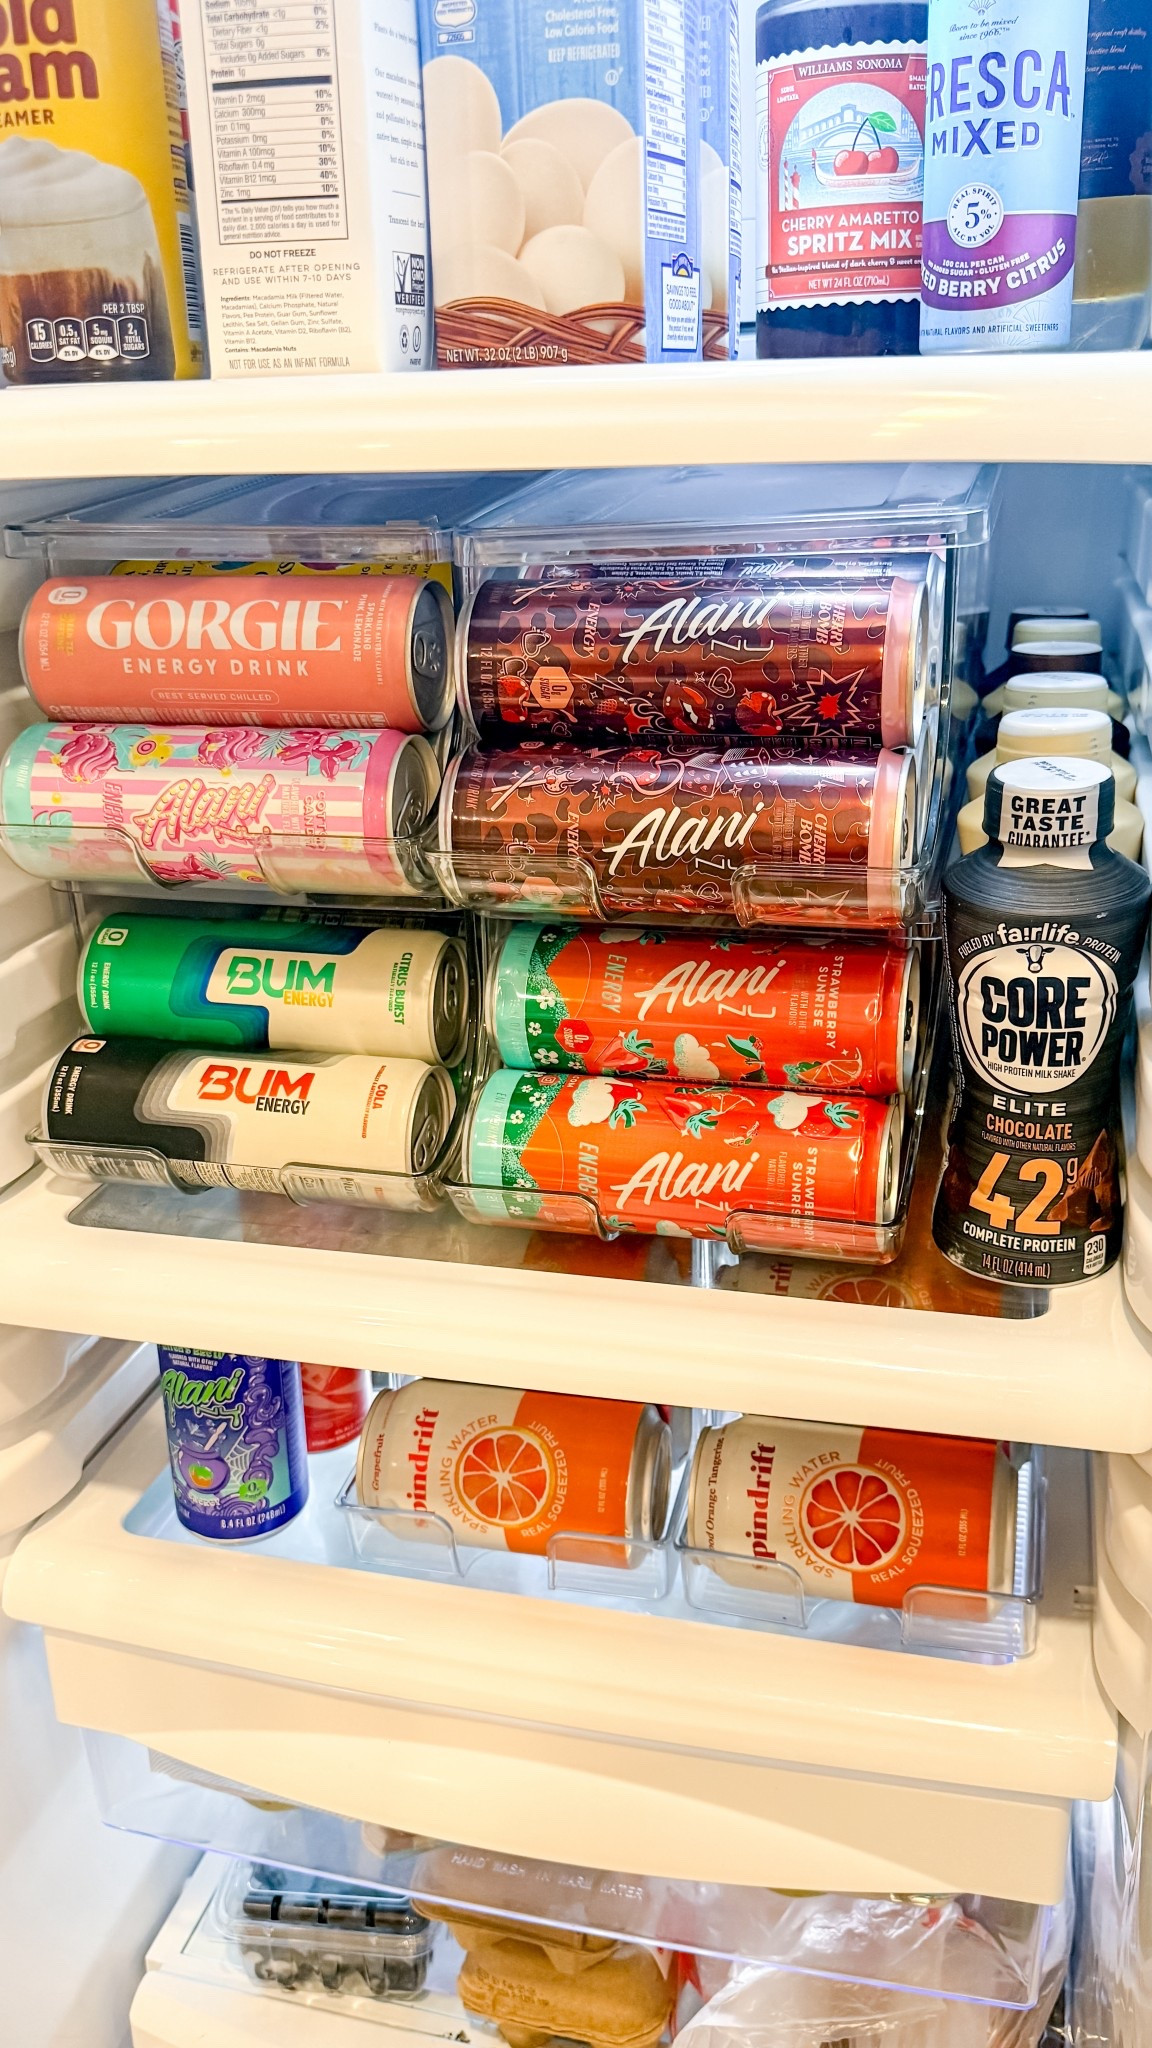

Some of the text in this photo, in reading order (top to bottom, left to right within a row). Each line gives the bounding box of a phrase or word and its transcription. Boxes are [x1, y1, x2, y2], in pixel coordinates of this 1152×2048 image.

[224, 10, 270, 22] Carbohydrate
[597, 22, 619, 34] Food
[548, 43, 621, 63] KEEP REFRIGERATED
[211, 69, 235, 79] Protein
[798, 58, 903, 78] WILLIAMS SONOMA
[314, 89, 332, 99] 10%
[927, 50, 1071, 123] RESCA
[0, 109, 54, 128] AMER
[315, 103, 333, 113] 25%
[318, 143, 336, 153] 10%
[931, 118, 1041, 158] MIXED
[318, 157, 337, 167] 30%
[319, 170, 338, 180] 40%
[321, 183, 339, 193] 10%
[953, 187, 997, 210] REAL SPIRIT
[781, 210, 920, 233] CHERRY AMARETTO
[964, 201, 992, 229] 5%
[787, 230, 864, 256] SPRITZ
[871, 229, 913, 250] MIX
[952, 224, 995, 241] ALC VOL
[250, 248, 316, 259] DO NOT FREEZE
[412, 257, 425, 269] NON
[942, 255, 1005, 269] 100 CAL PER CAN
[950, 252, 1031, 277] SUGAR GLUTEN FREE
[213, 262, 361, 276] REFRIGERATE AFTER OPENING
[222, 273, 352, 286] AND USE WITHIN 7-10 DAYS
[937, 237, 1067, 298] BERRY CITRUS
[808, 280, 822, 291] NET
[103, 302, 145, 314] PER TBSP
[397, 293, 425, 305] VERIFIED
[32, 323, 46, 341] 15
[944, 323, 1059, 336] FLAVORS AND ARTIFICIAL SWEETENERS
[229, 359, 241, 369] NOT
[243, 359, 256, 369] FOR
[257, 358, 270, 369] USE
[319, 356, 350, 368] FORMULA
[446, 345, 559, 363] NET WT. 32 OZ LB) 907
[86, 598, 343, 653] GORGIE
[353, 593, 369, 663] PINK LEMONADE
[363, 602, 376, 651] SPARKLING
[583, 602, 601, 658] ENERGY
[619, 592, 785, 664] Alani
[815, 602, 832, 645] BOMB
[123, 658, 310, 677] ENERGY DRINK
[158, 692, 273, 703] BEST SERVED CHILLED
[132, 774, 278, 850] Alani
[466, 789, 480, 811] DRINK
[1011, 796, 1087, 815] GREAT
[1011, 814, 1084, 832] TASTE
[601, 801, 765, 875] Alani
[798, 817, 813, 865] BOMB
[957, 938, 982, 960] FUELED
[982, 932, 995, 946] BY
[1082, 937, 1122, 964] PROTEIN
[102, 962, 112, 1010] ENERGY DRINK
[226, 956, 337, 998] BUM
[394, 952, 413, 1025] CITRUS BURST
[601, 953, 628, 1014] ENERGY
[283, 988, 335, 1008] ENERGY
[634, 959, 787, 1021] Alani
[813, 966, 829, 1027] SUNRISE
[825, 955, 844, 1049] STRAWBERRY
[788, 994, 799, 1026] FLAVORS
[980, 975, 1091, 1030] CORE
[987, 1061, 1076, 1079] HIGH PROTEIN MILK SHAKE
[64, 1065, 82, 1115] ENERGY DRINK
[197, 1064, 316, 1105] BUM
[372, 1083, 389, 1110] COLA
[255, 1096, 311, 1115] ENERGY
[993, 1094, 1067, 1117] ELITE
[986, 1113, 1073, 1140] CHOCOLATE
[1016, 1140, 1077, 1152] OTHER NATURAL FLAVORS
[610, 1151, 760, 1210] Alani
[962, 1220, 1076, 1253] COMPLETE PROTEIN
[1086, 1237, 1104, 1256] 230
[982, 1253, 1033, 1277] 14 FL OZ (414
[161, 1368, 245, 1418] Alani
[371, 1433, 386, 1492] Grapefruit
[440, 1413, 499, 1535] SPARKLING WATER
[520, 1419, 569, 1538] REAL SQUEEZED FRUIT
[707, 1437, 725, 1530] Orange Tangerine
[782, 1451, 842, 1579] SPARKLING WATER
[871, 1458, 925, 1584] REAL SQUEEZED FRUIT
